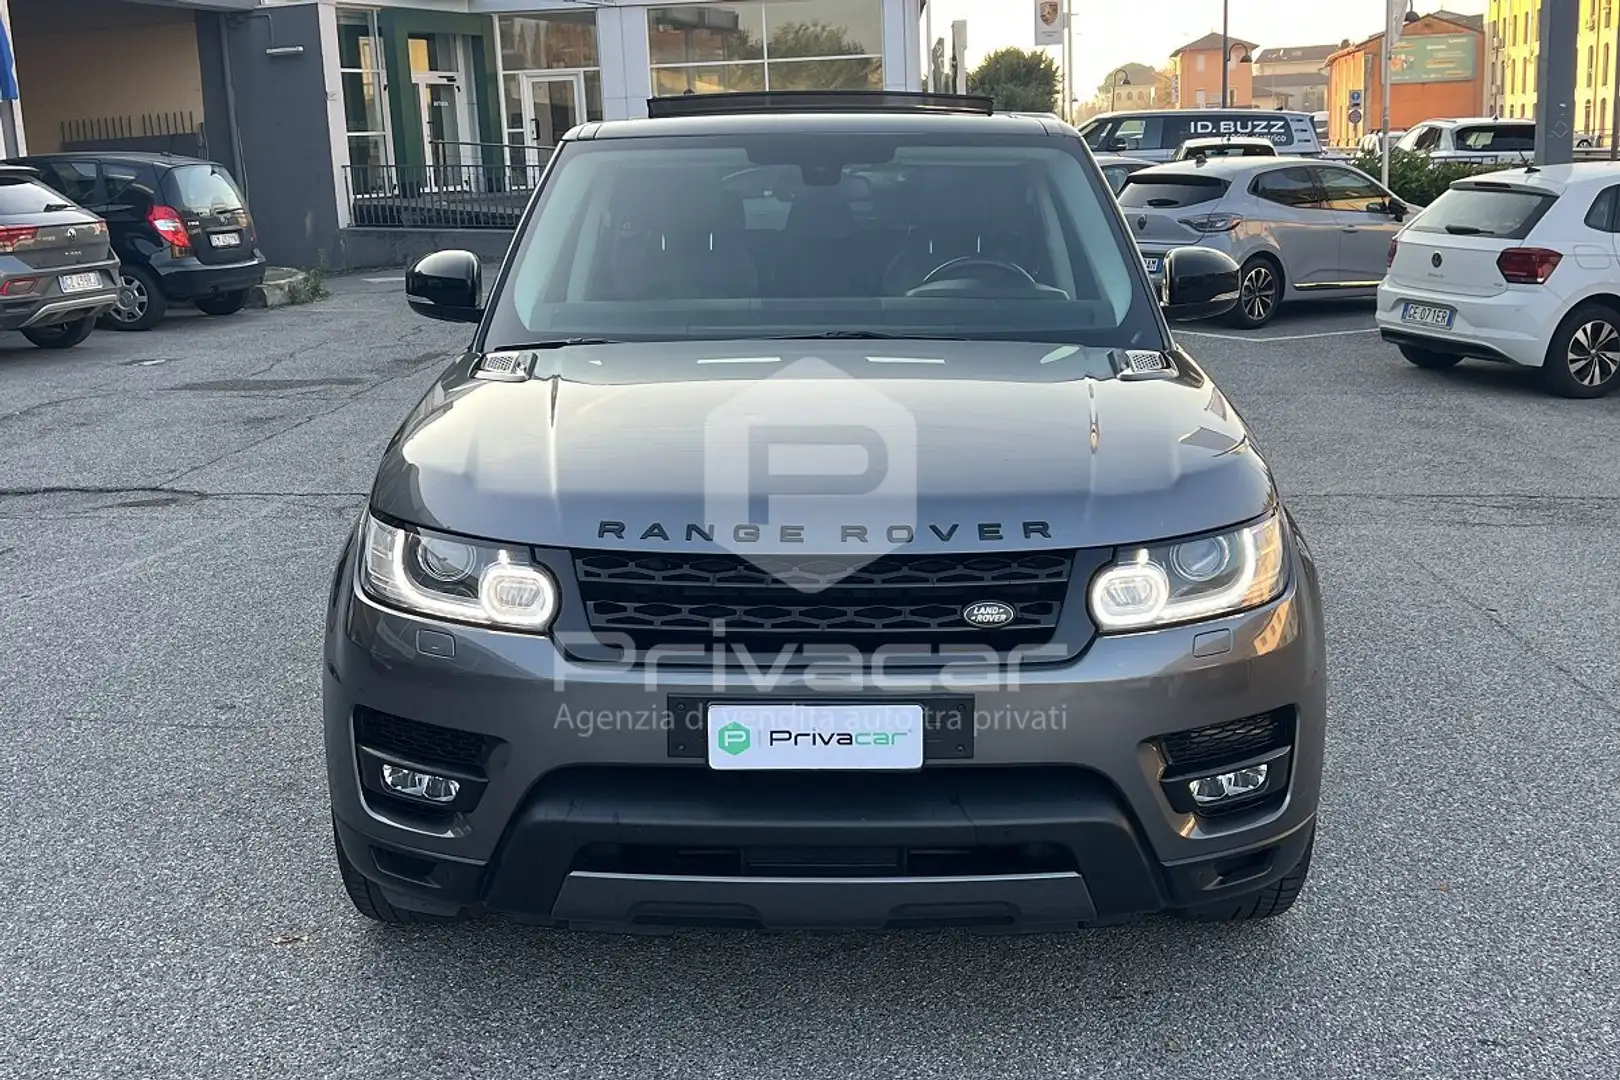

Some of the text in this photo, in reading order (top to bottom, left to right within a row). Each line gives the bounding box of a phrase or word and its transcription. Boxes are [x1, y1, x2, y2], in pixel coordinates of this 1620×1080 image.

[597, 520, 1053, 543] RANGE ROVER
[973, 606, 999, 614] LAND
[976, 614, 1007, 622] ROVER
[769, 729, 908, 746] Privacar
